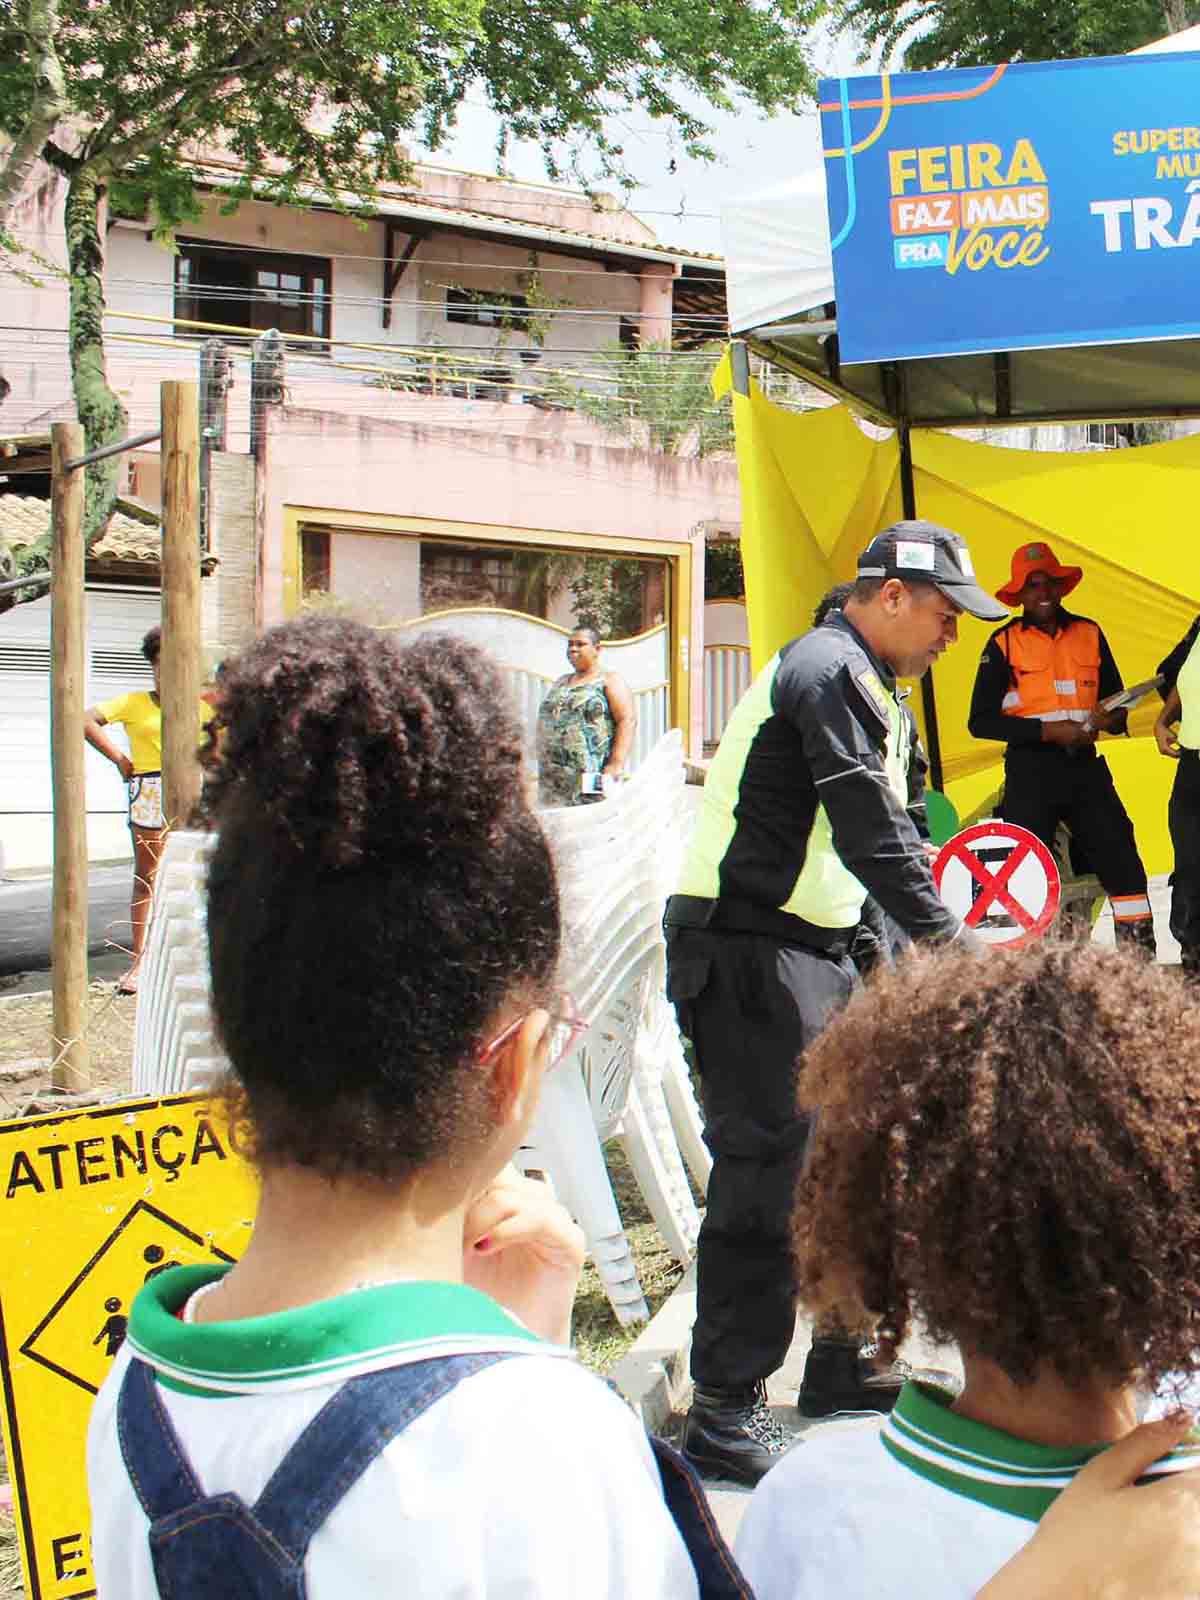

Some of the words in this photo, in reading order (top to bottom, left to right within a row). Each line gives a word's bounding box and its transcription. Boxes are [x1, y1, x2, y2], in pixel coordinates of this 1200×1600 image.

[888, 139, 1048, 195] FEIRA
[898, 200, 953, 230] FAZ
[967, 192, 1045, 224] MAIS
[900, 240, 942, 262] PRA
